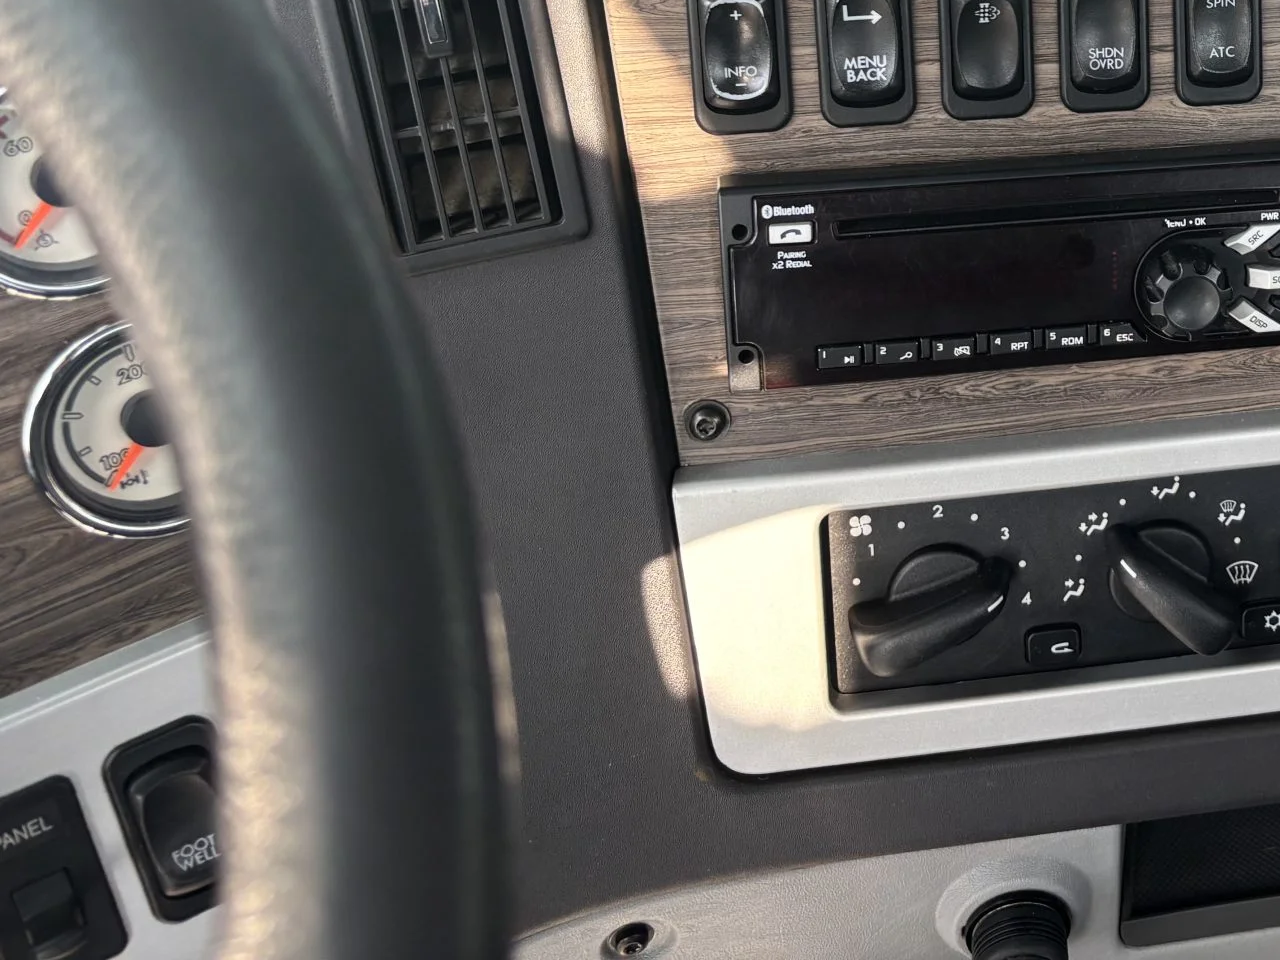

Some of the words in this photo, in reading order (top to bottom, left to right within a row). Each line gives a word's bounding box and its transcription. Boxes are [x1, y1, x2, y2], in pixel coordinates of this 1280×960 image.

[1088, 47, 1125, 60] SHDN
[1209, 45, 1236, 59] ATC
[843, 54, 887, 70] MENU
[1089, 58, 1124, 71] OVRD
[724, 65, 758, 79] INFO
[846, 67, 888, 82] BACK
[773, 204, 815, 217] Bluetooth
[1260, 211, 1280, 221] PWR
[1194, 217, 1207, 226] OK
[1247, 230, 1264, 246] SRC
[1249, 315, 1268, 329] DISP
[994, 337, 1001, 346] 4
[1049, 331, 1057, 341] 5
[1061, 336, 1084, 346] RDM
[1116, 333, 1134, 342] ESC
[879, 346, 887, 355] 2
[936, 342, 944, 352] 3
[1010, 341, 1029, 351] RPT
[933, 505, 944, 519] 2
[1000, 527, 1010, 540] 3
[867, 544, 876, 557] 1
[1020, 592, 1033, 606] 4
[0, 816, 54, 850] ANEL
[171, 833, 217, 859] FOOT
[175, 846, 223, 872] WELL
